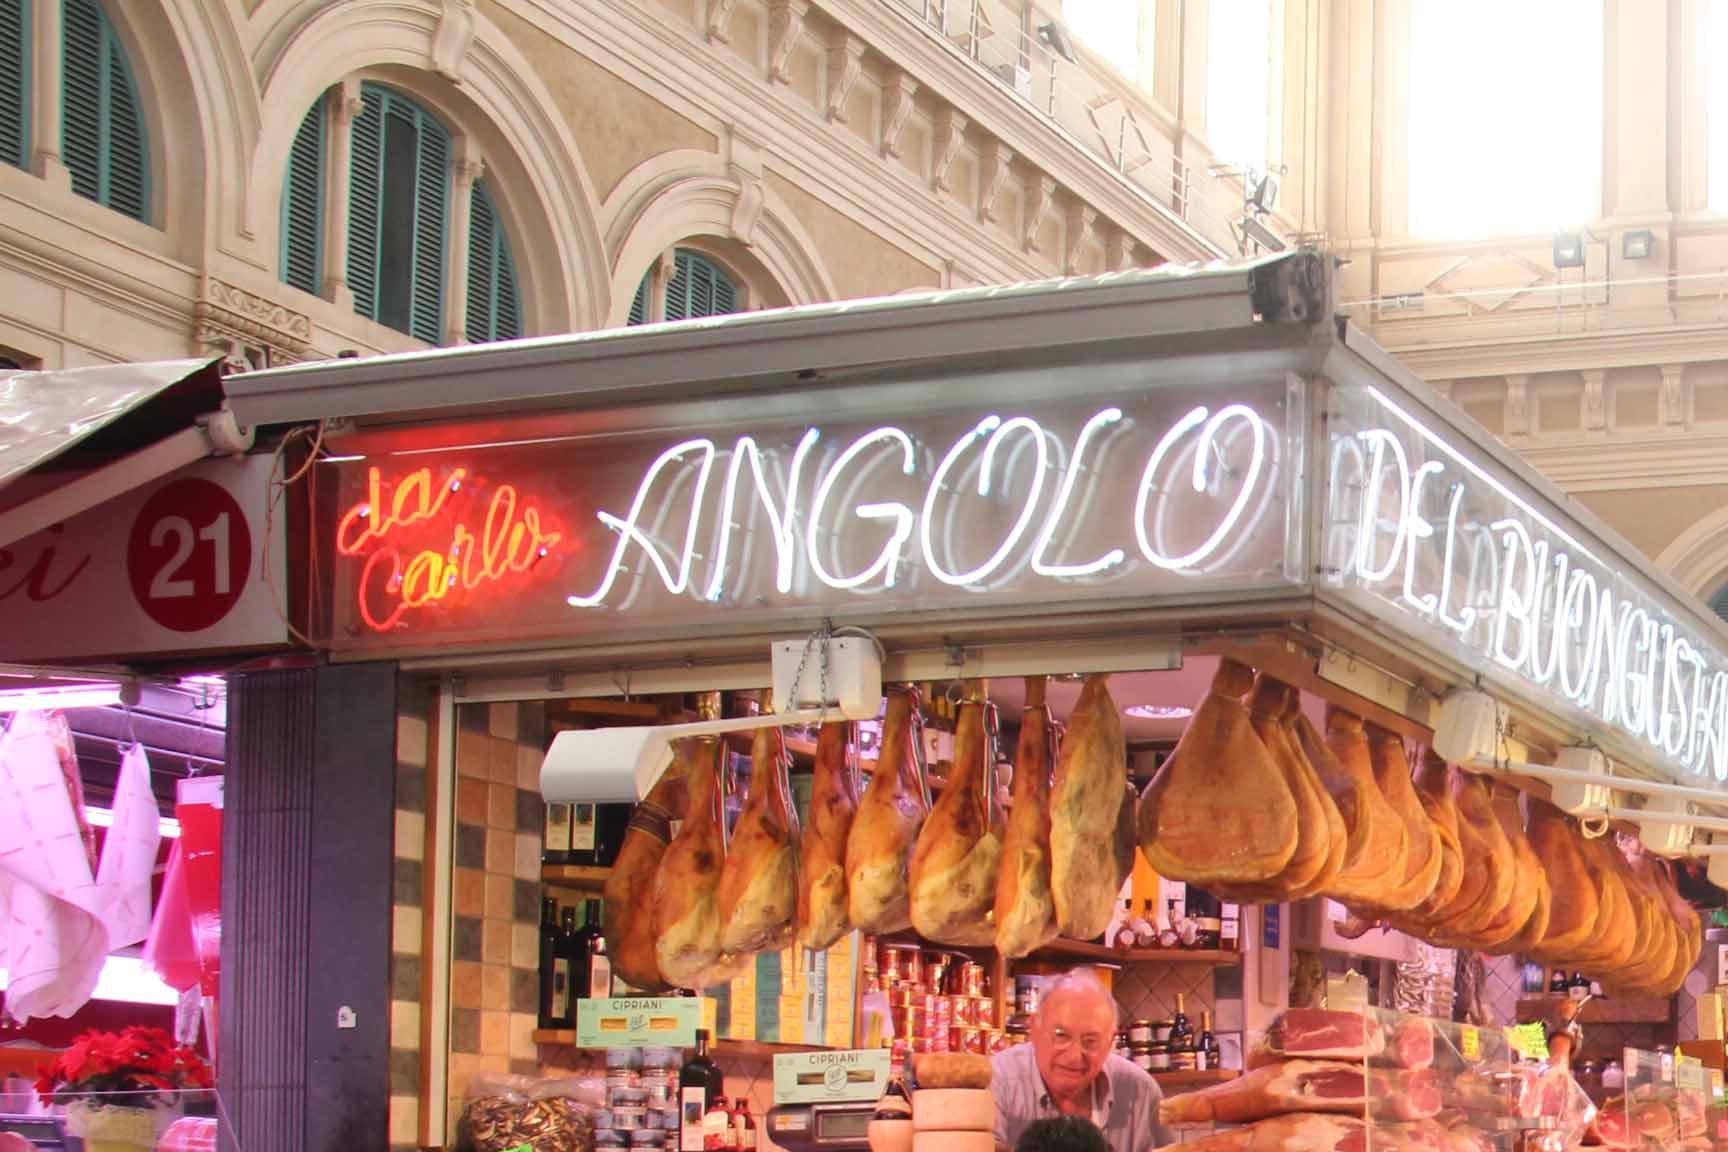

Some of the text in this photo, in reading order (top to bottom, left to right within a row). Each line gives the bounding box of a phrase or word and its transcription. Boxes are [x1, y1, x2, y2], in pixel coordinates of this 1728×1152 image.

[337, 466, 466, 555] da
[568, 404, 1264, 607] ANGOLO
[1356, 428, 1477, 632] DEL
[149, 511, 230, 598] 21
[359, 485, 561, 632] Carlo
[611, 999, 663, 1010] CIPRIANI
[808, 1053, 859, 1065] CIPRIANI
